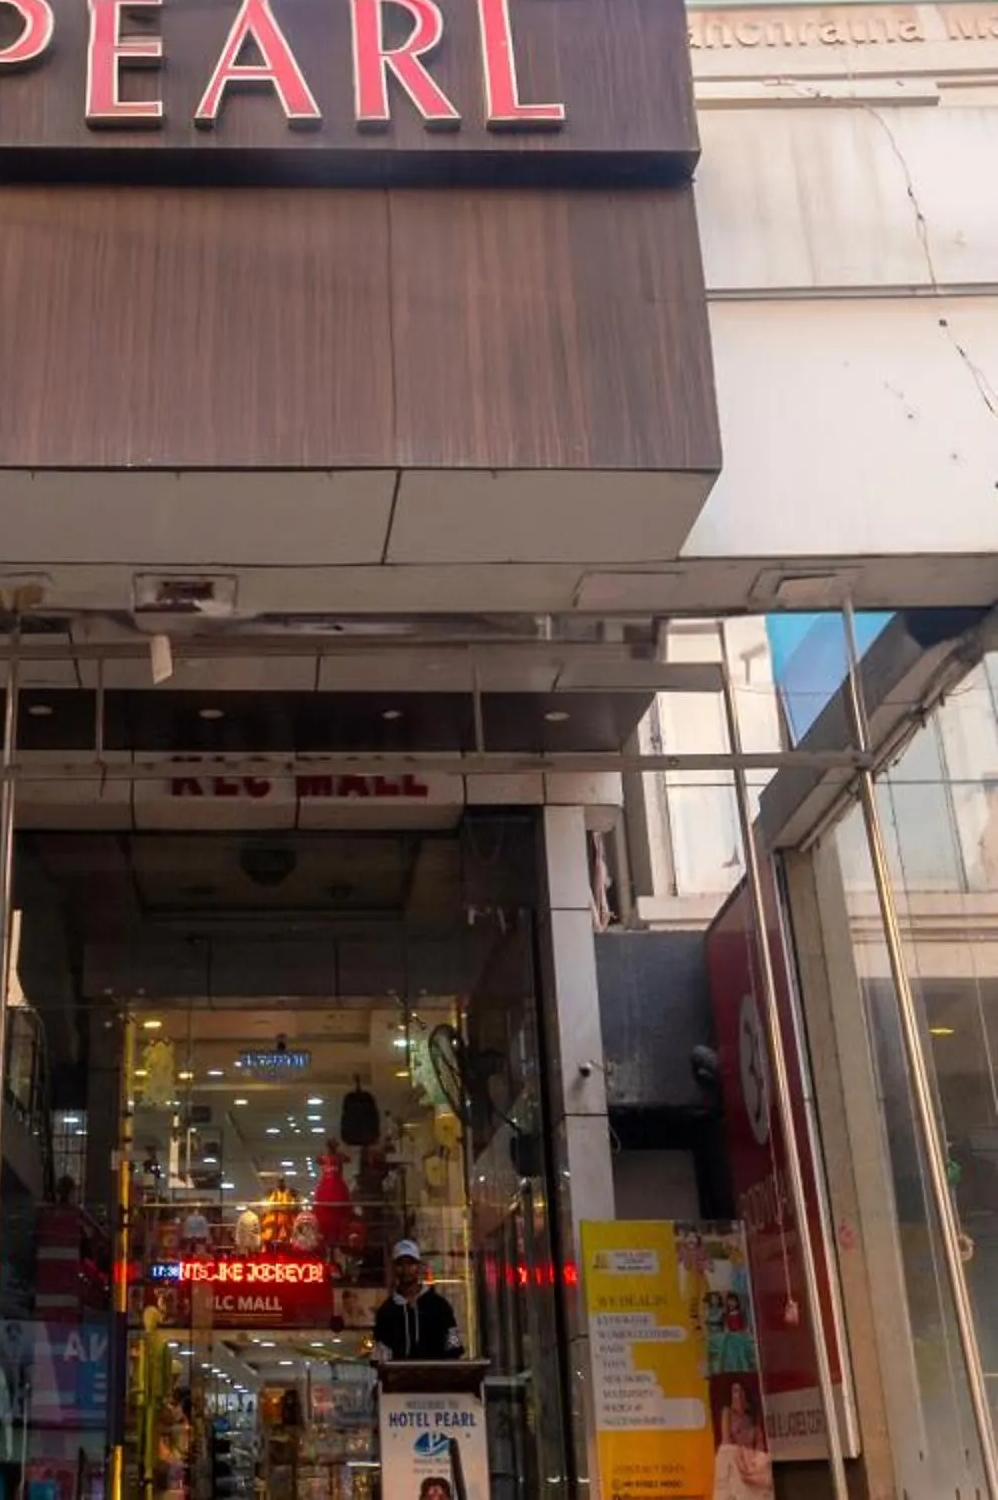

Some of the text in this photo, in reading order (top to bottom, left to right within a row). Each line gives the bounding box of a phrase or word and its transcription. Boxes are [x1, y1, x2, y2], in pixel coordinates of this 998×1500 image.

[238, 1295, 283, 1311] MALL
[389, 1411, 477, 1428] HOTEL PEARL
